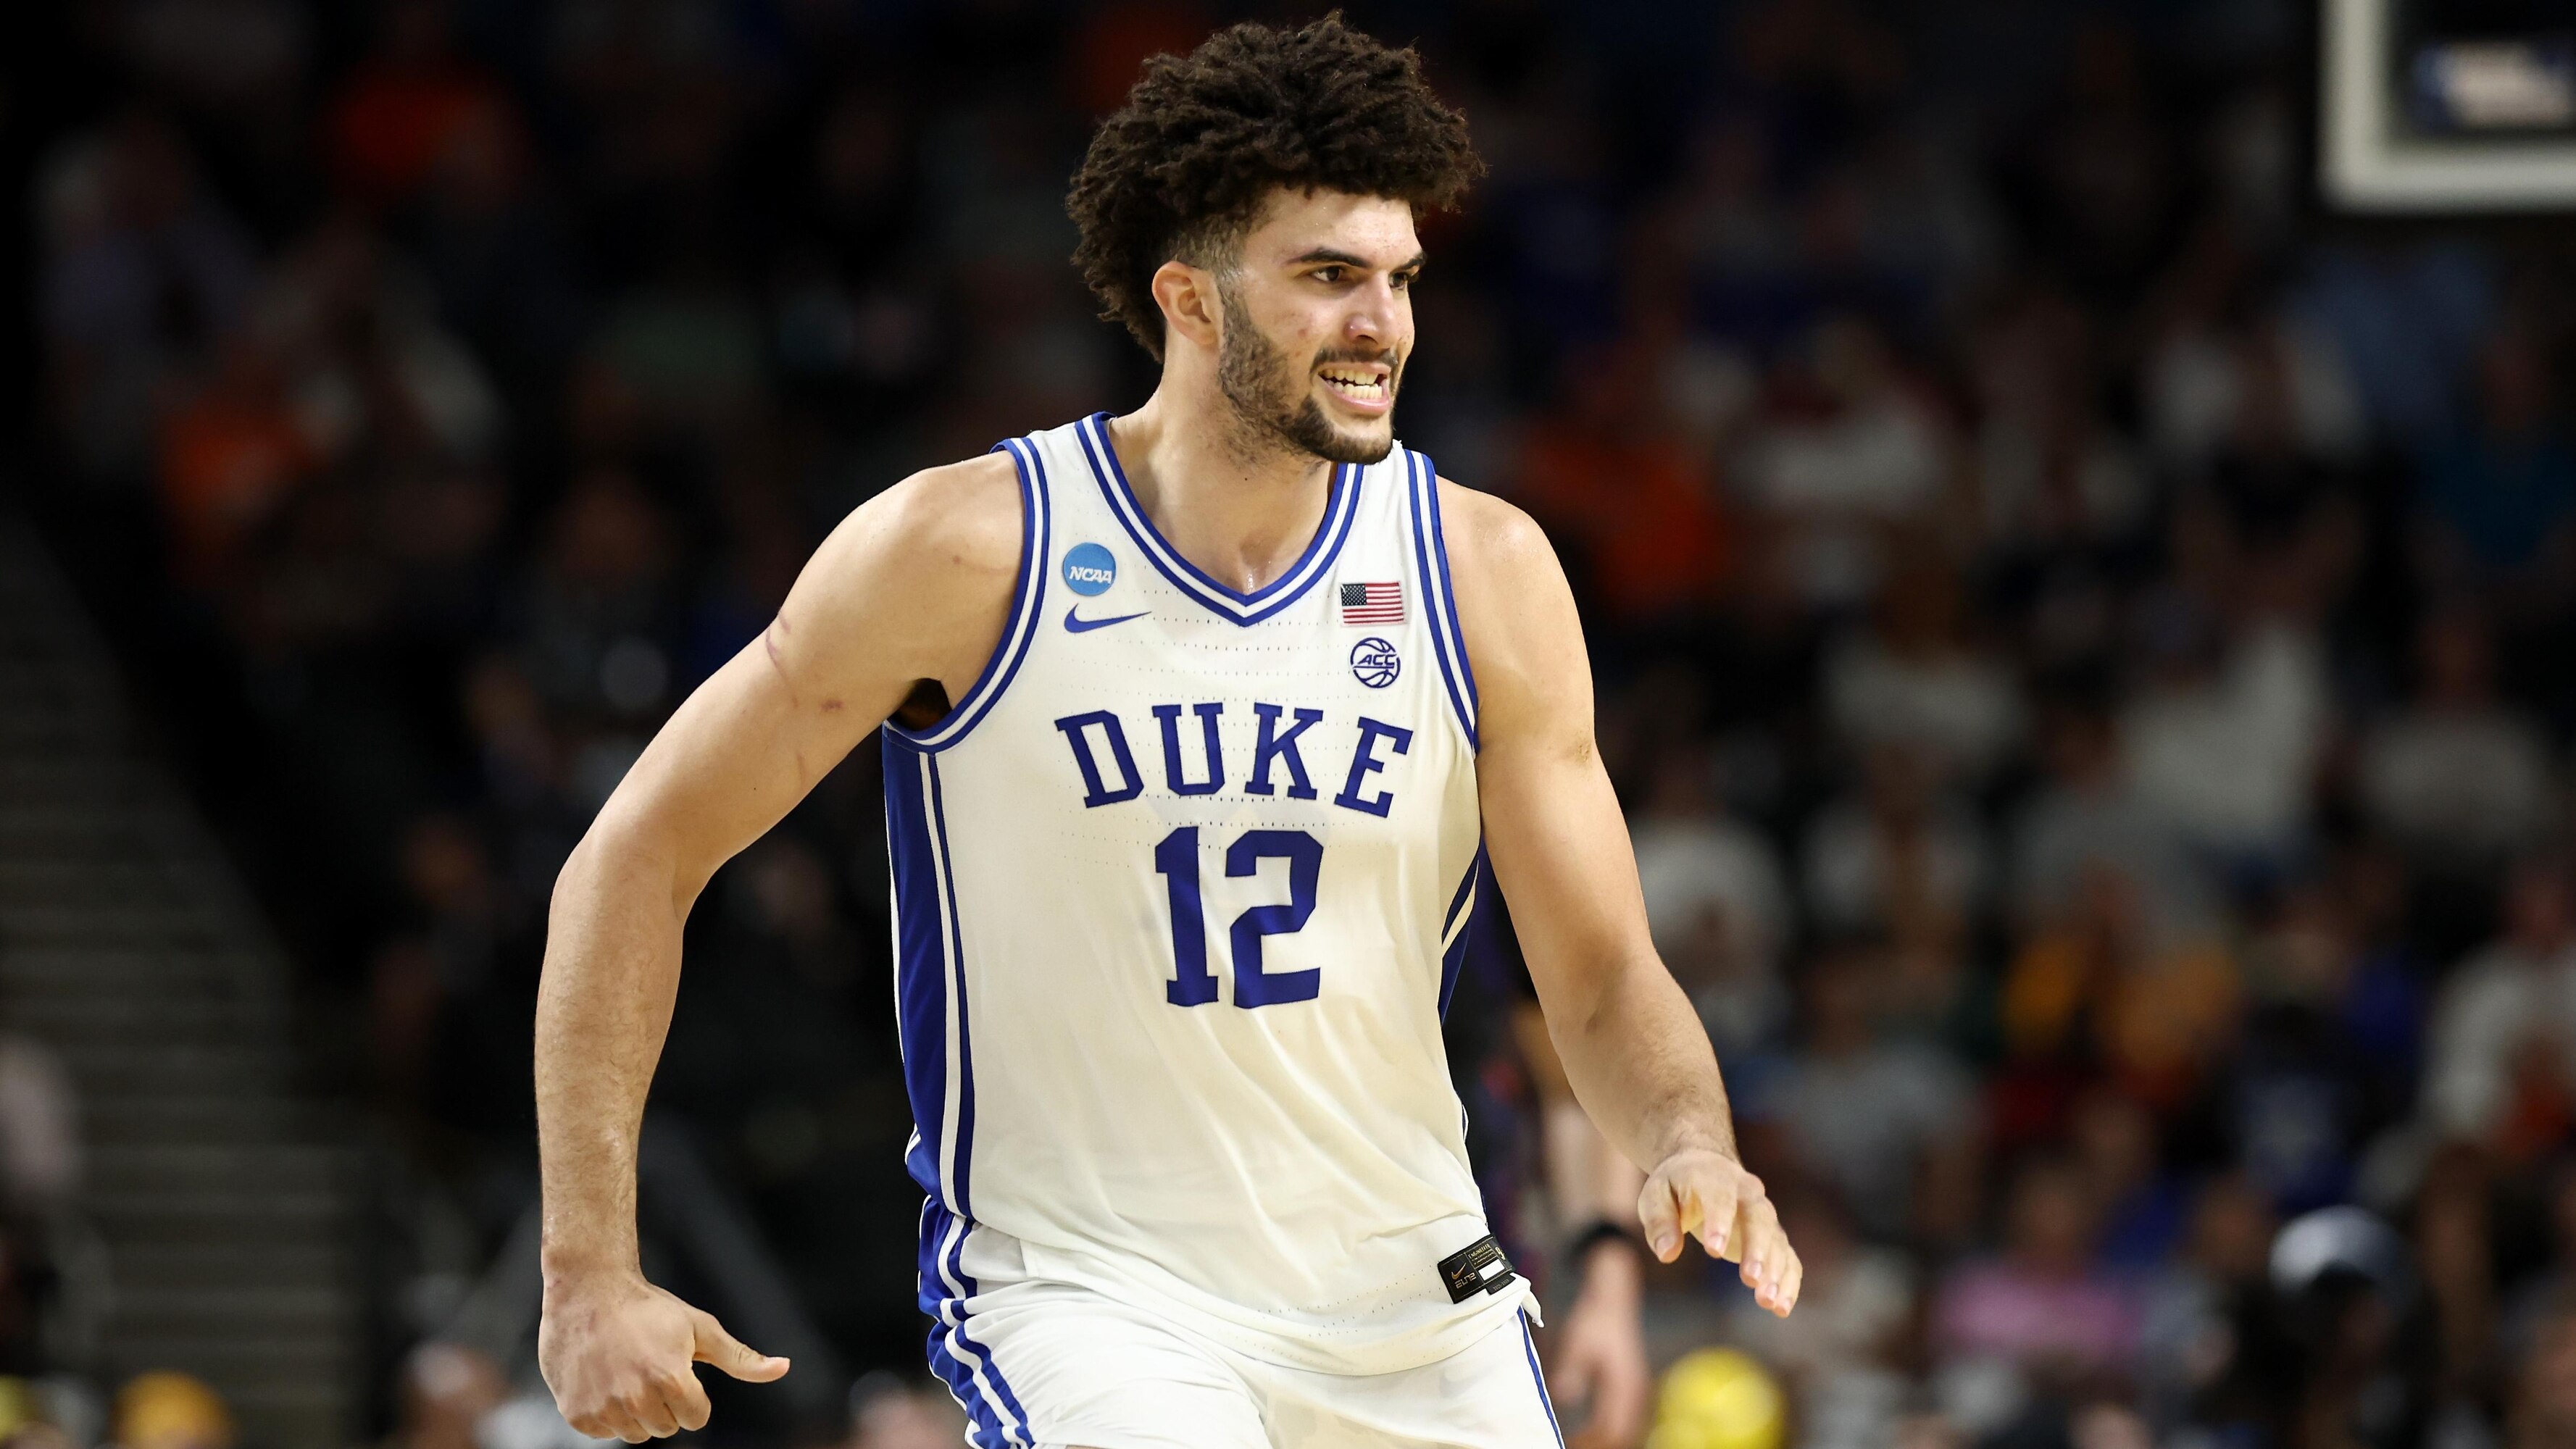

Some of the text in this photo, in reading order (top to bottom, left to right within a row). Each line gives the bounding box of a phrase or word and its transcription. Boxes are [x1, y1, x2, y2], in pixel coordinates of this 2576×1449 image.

[1069, 566, 1112, 584] NCAA
[1357, 654, 1397, 665] ACC
[1054, 702, 1413, 818] DUKE
[1155, 826, 1324, 1009] 12
